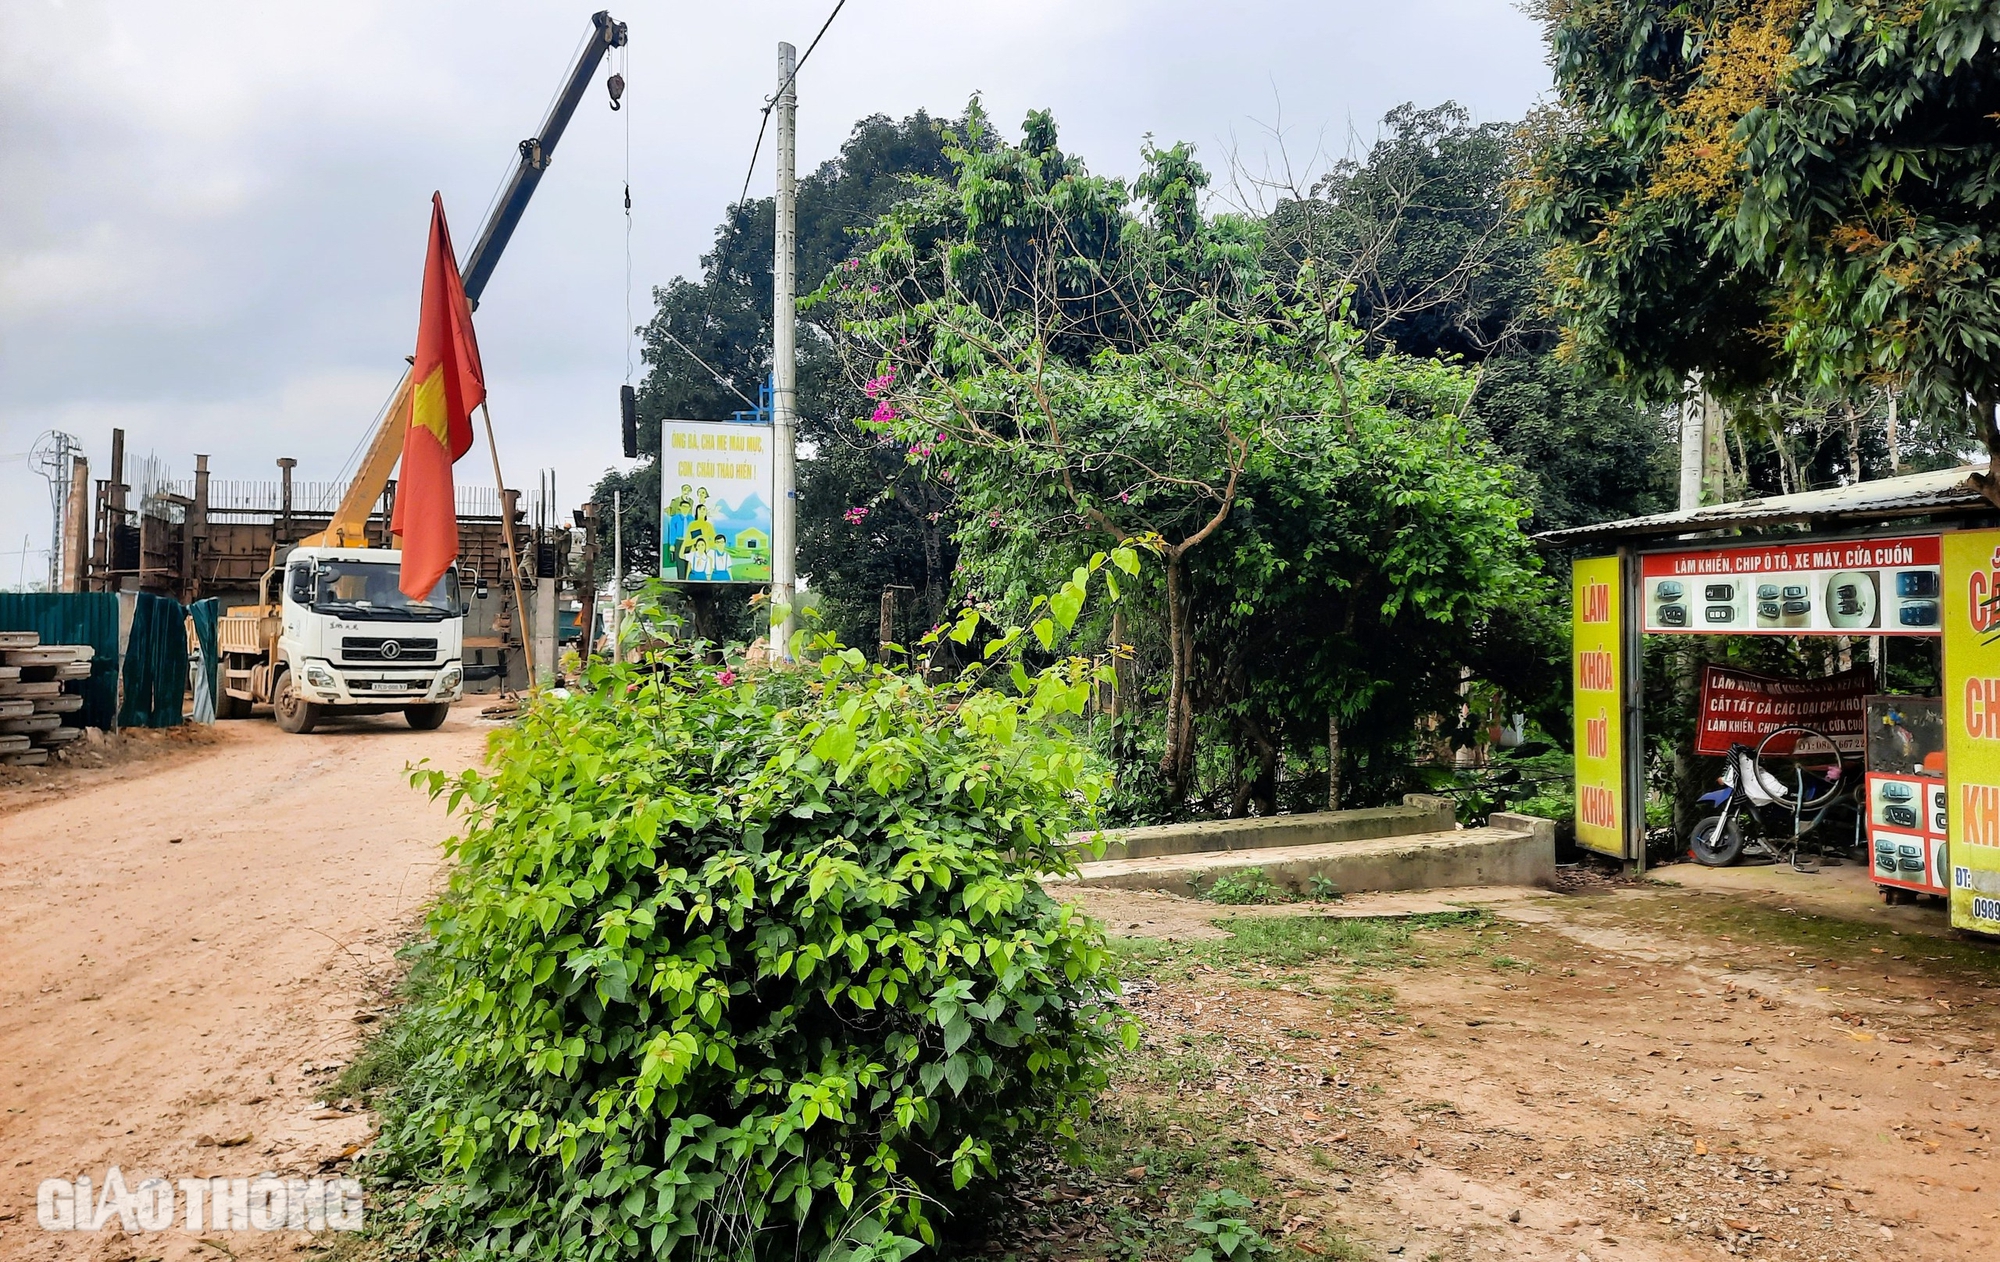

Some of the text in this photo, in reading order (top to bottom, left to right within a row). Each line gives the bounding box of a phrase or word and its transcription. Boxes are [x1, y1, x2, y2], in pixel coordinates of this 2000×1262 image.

[701, 434, 715, 450] CHA
[716, 434, 728, 454] MẸ
[696, 458, 715, 478] CHÁU
[1675, 558, 1696, 574] LÀM
[1736, 556, 1762, 572] CHIP
[1764, 552, 1772, 570] Ô
[1774, 551, 1792, 571] TÔ,
[1795, 553, 1810, 569] XE
[1813, 548, 1843, 569] MÁY,
[1846, 545, 1871, 566] CỬA
[1875, 542, 1913, 565] CUỐN
[1582, 577, 1609, 622] LÀM
[1580, 644, 1613, 691] KHÓA
[1797, 702, 1818, 717] LOẠI
[1587, 708, 1608, 759] MỞ
[1707, 718, 1727, 731] LÀM
[1848, 715, 1864, 731] CUỐ
[1581, 781, 1616, 829] KHÓA
[1955, 867, 1971, 888] ĐT:
